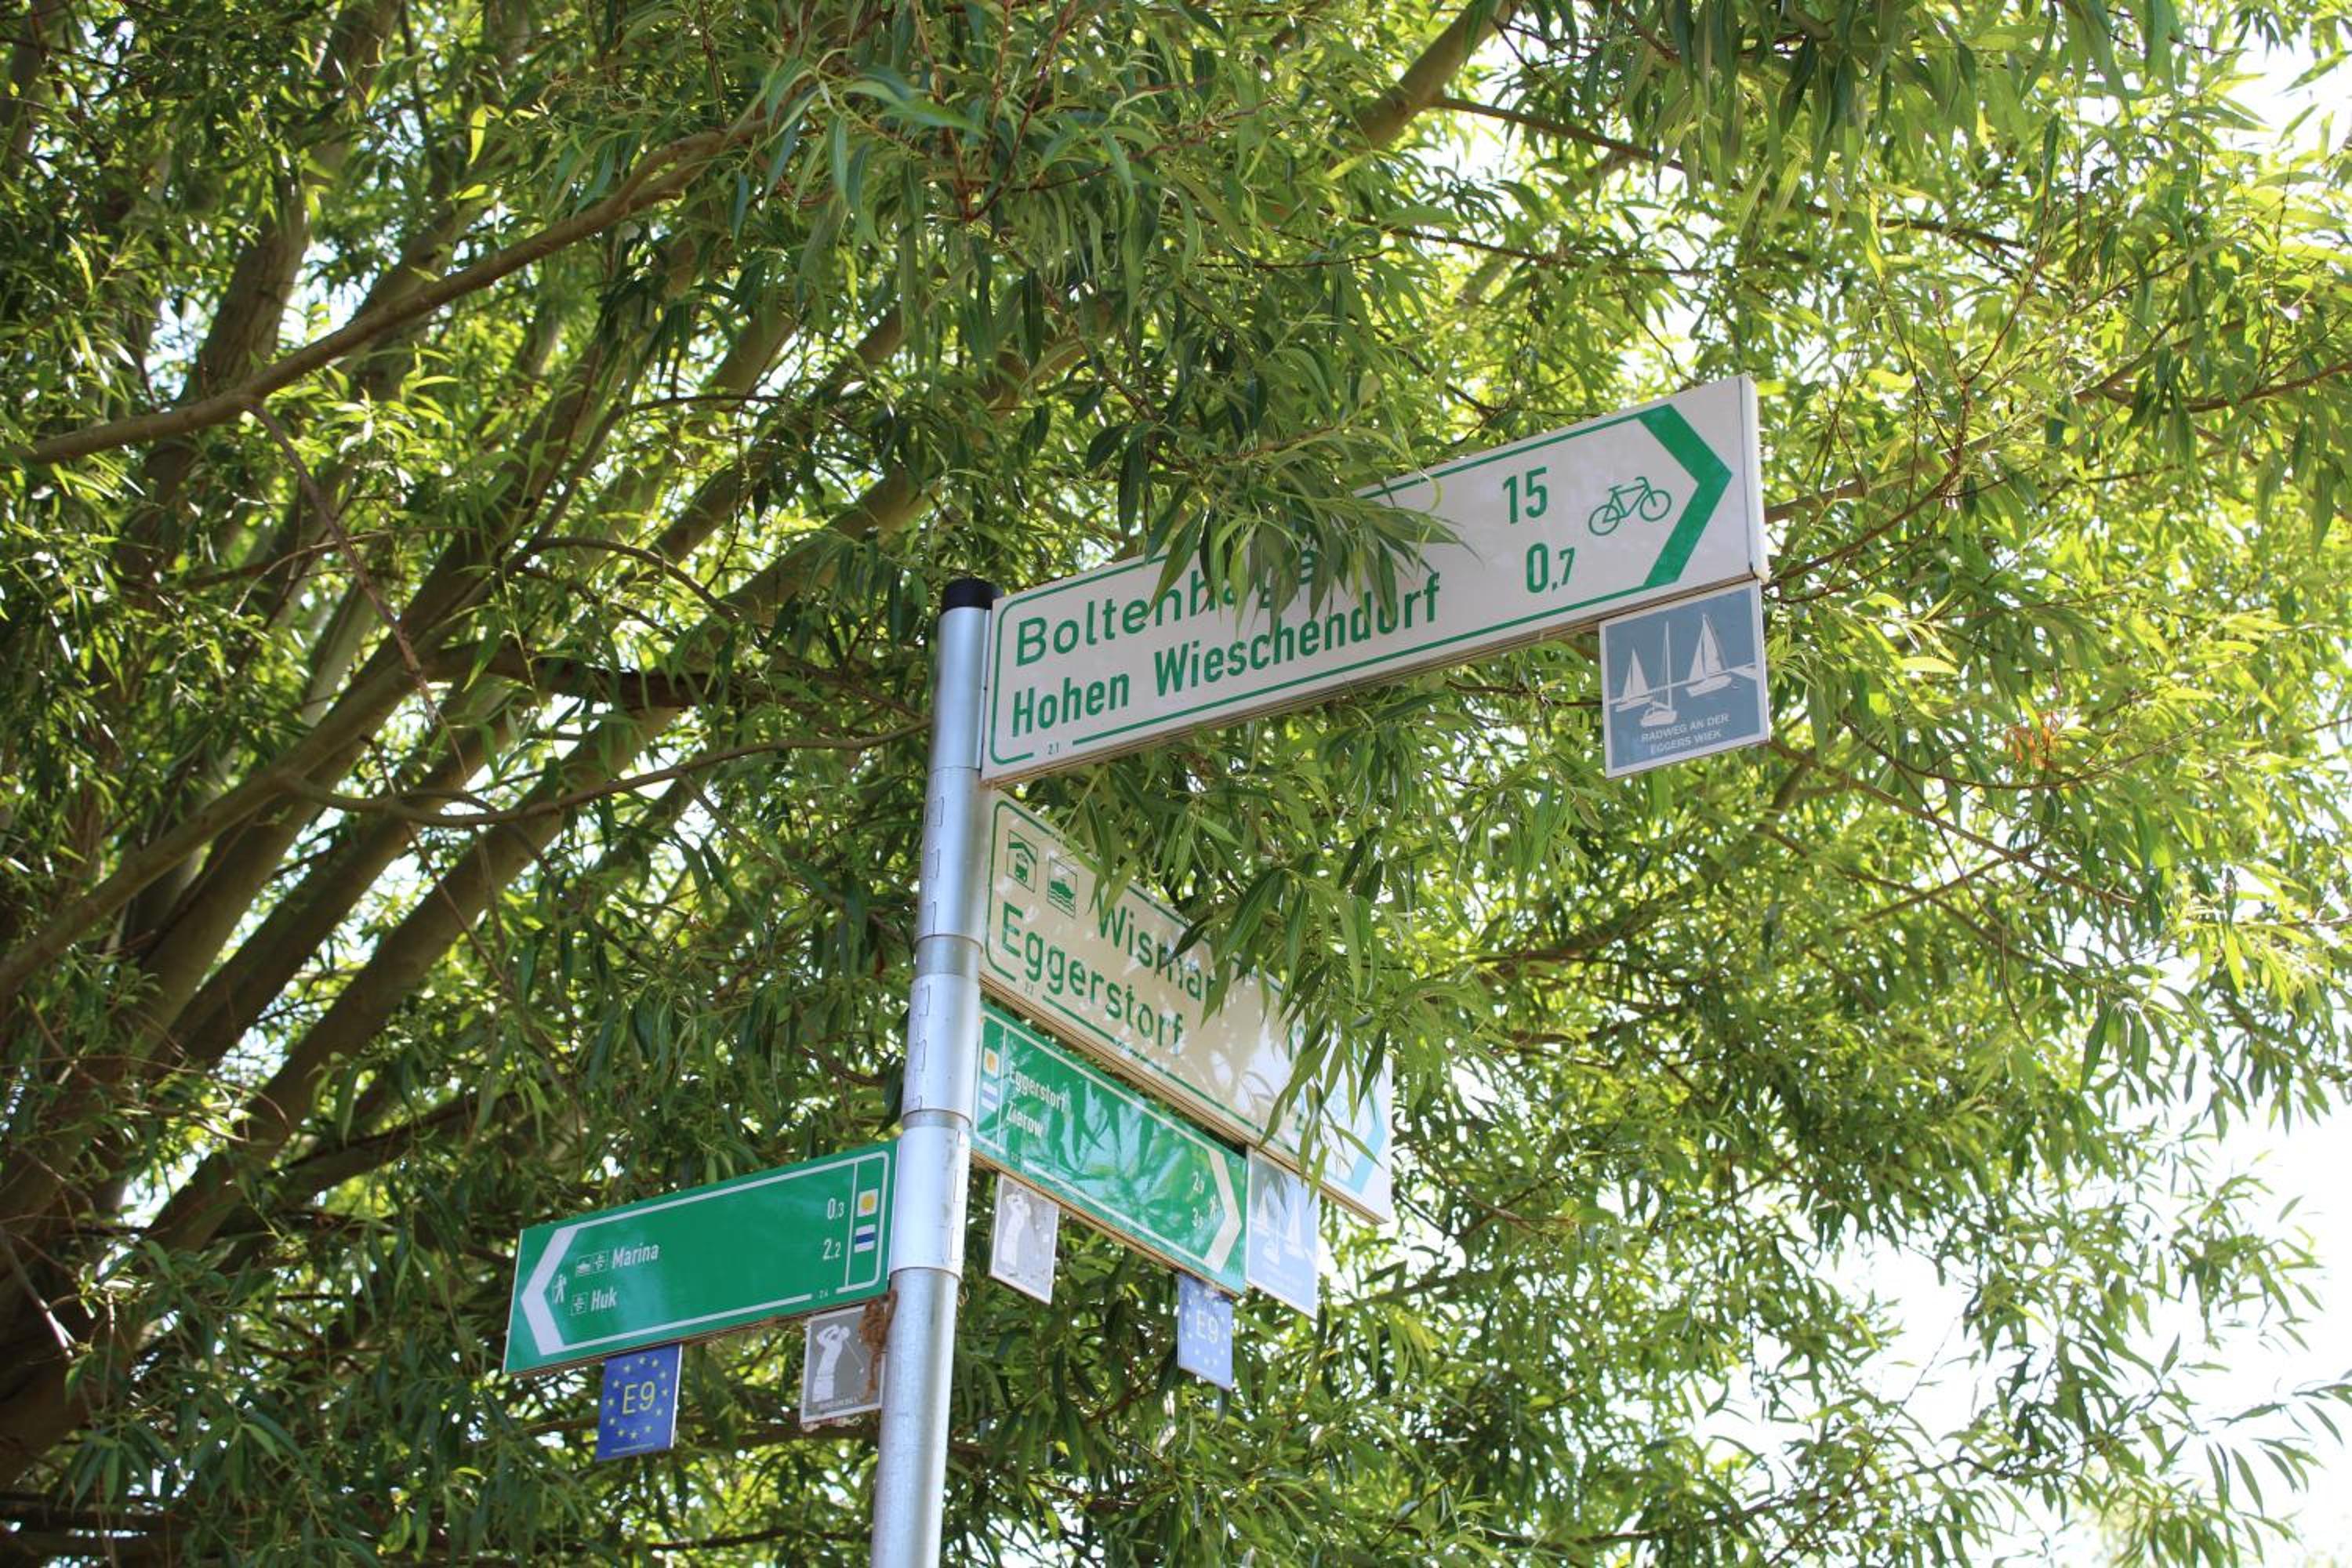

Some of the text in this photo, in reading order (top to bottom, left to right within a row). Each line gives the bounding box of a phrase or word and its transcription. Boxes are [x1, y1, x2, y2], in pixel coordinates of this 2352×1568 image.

[1502, 466, 1548, 524] 15
[1013, 572, 1441, 738] Hohen Wieschendorf
[1642, 713, 1729, 742] RADWEG AN DER
[1002, 902, 1183, 1047] Eggerstorf
[1008, 1062, 1070, 1113] Eggerstorf
[611, 1242, 659, 1269] Marina
[590, 1286, 619, 1312] Huk
[1196, 1307, 1219, 1343] E9
[622, 1380, 656, 1415] E9
